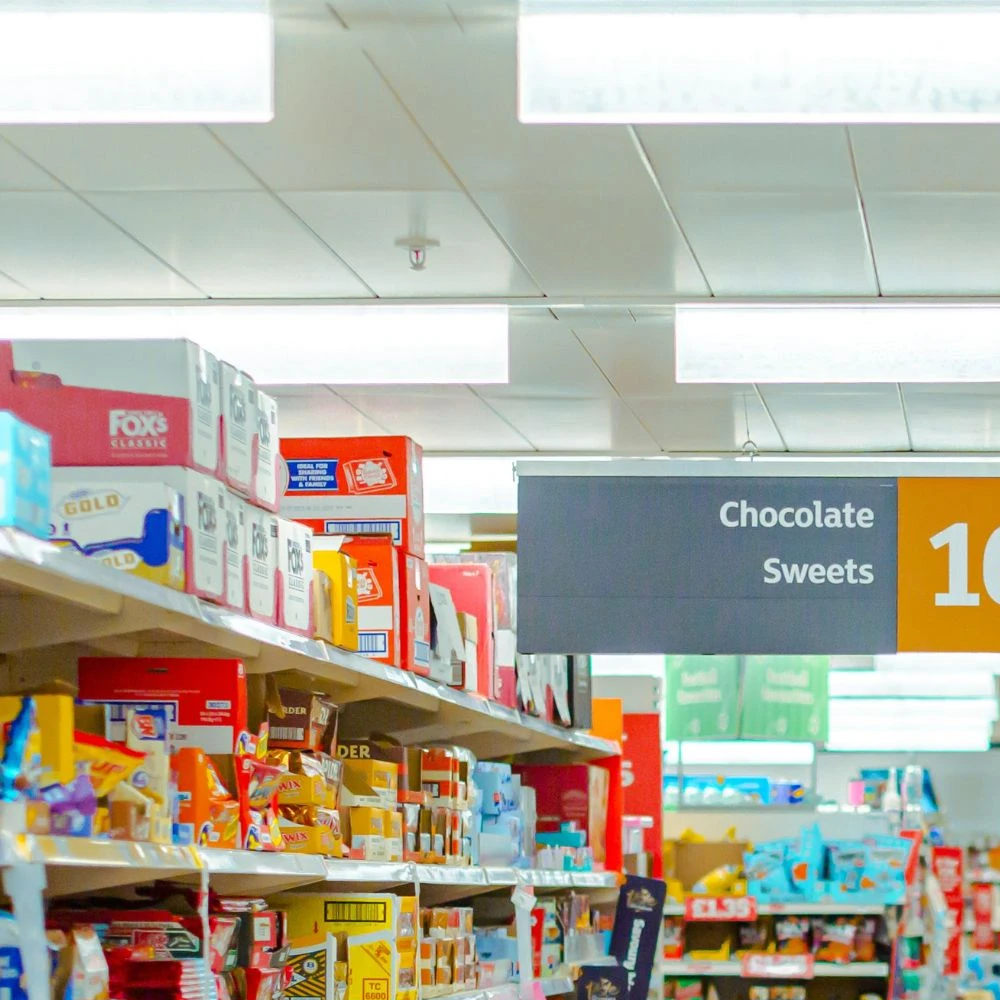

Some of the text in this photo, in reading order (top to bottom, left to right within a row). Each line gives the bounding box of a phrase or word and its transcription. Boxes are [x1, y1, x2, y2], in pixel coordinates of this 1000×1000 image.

[110, 439, 167, 448] CLASSIC
[64, 494, 119, 517] GOLD
[719, 500, 874, 528] Chocolate
[763, 557, 875, 585] Sweets
[337, 744, 371, 759] DER
[623, 918, 645, 975] Savoury
[368, 982, 381, 990] TC
[365, 992, 387, 1000] 6600
